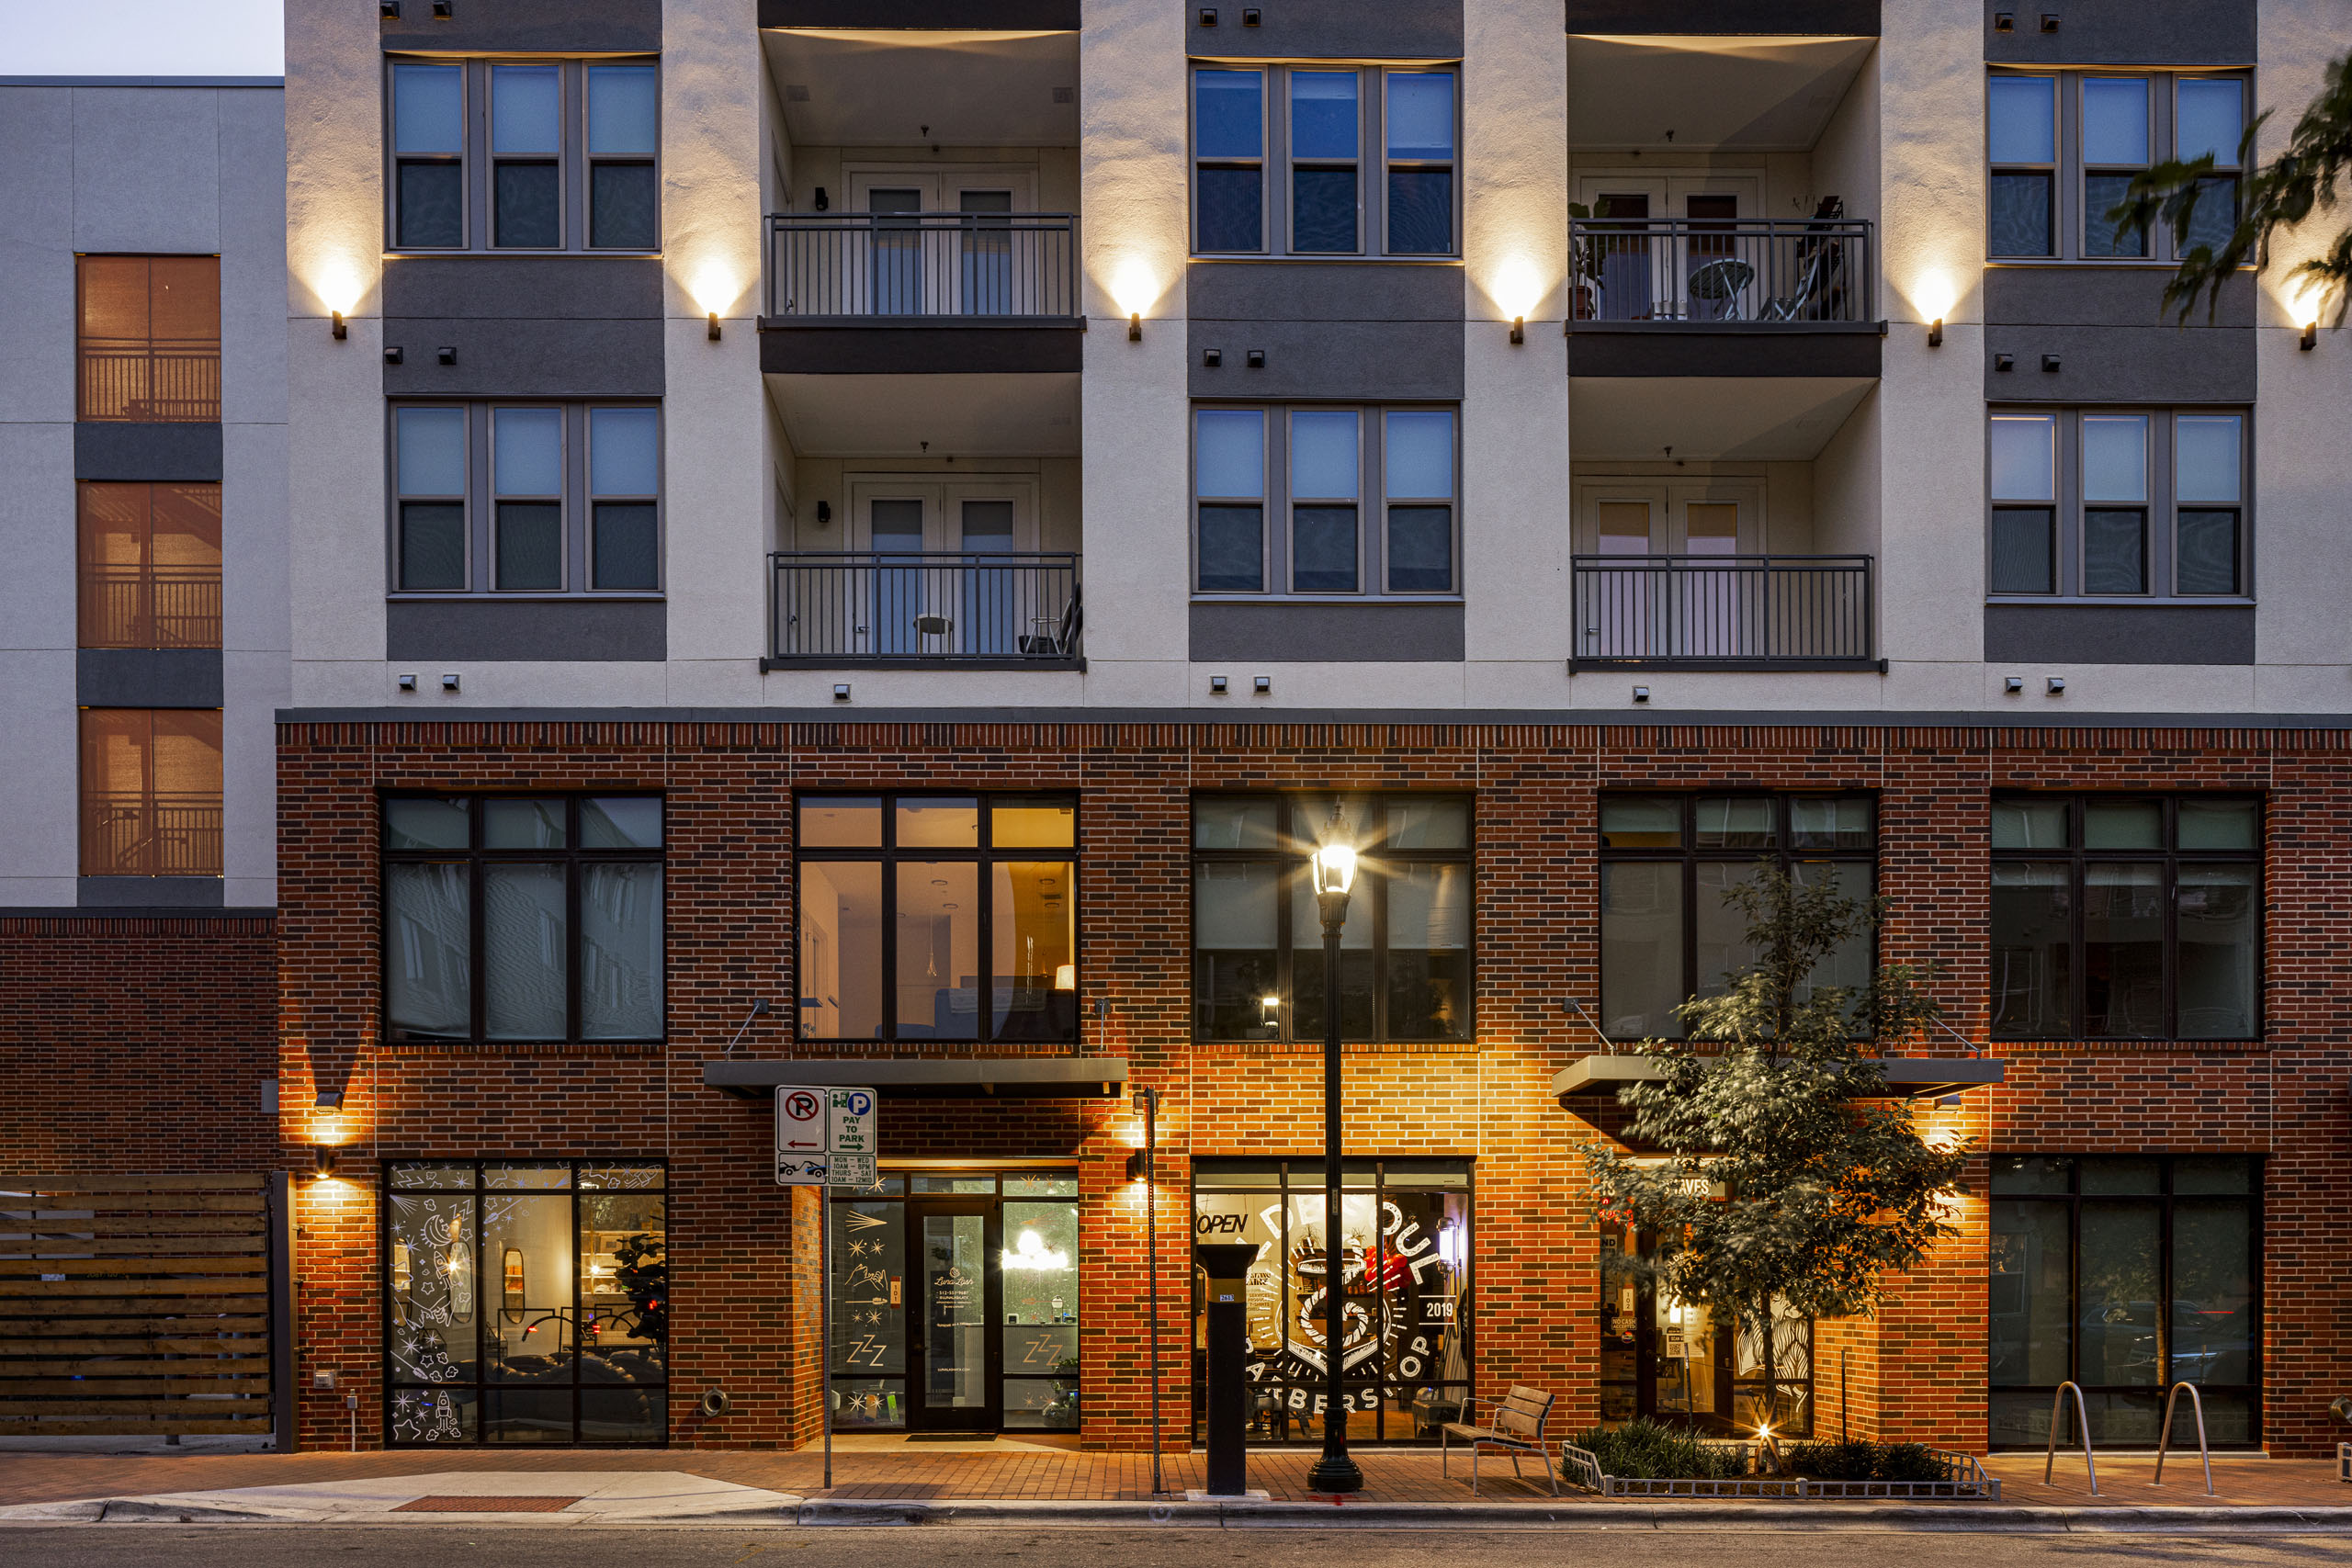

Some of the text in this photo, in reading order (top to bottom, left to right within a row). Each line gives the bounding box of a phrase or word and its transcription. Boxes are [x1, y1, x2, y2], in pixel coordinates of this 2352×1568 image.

[839, 1134, 865, 1143] PARK
[1197, 1213, 1249, 1234] OPEN
[934, 1276, 974, 1286] Luna Lash
[1426, 1303, 1453, 1317] 2019
